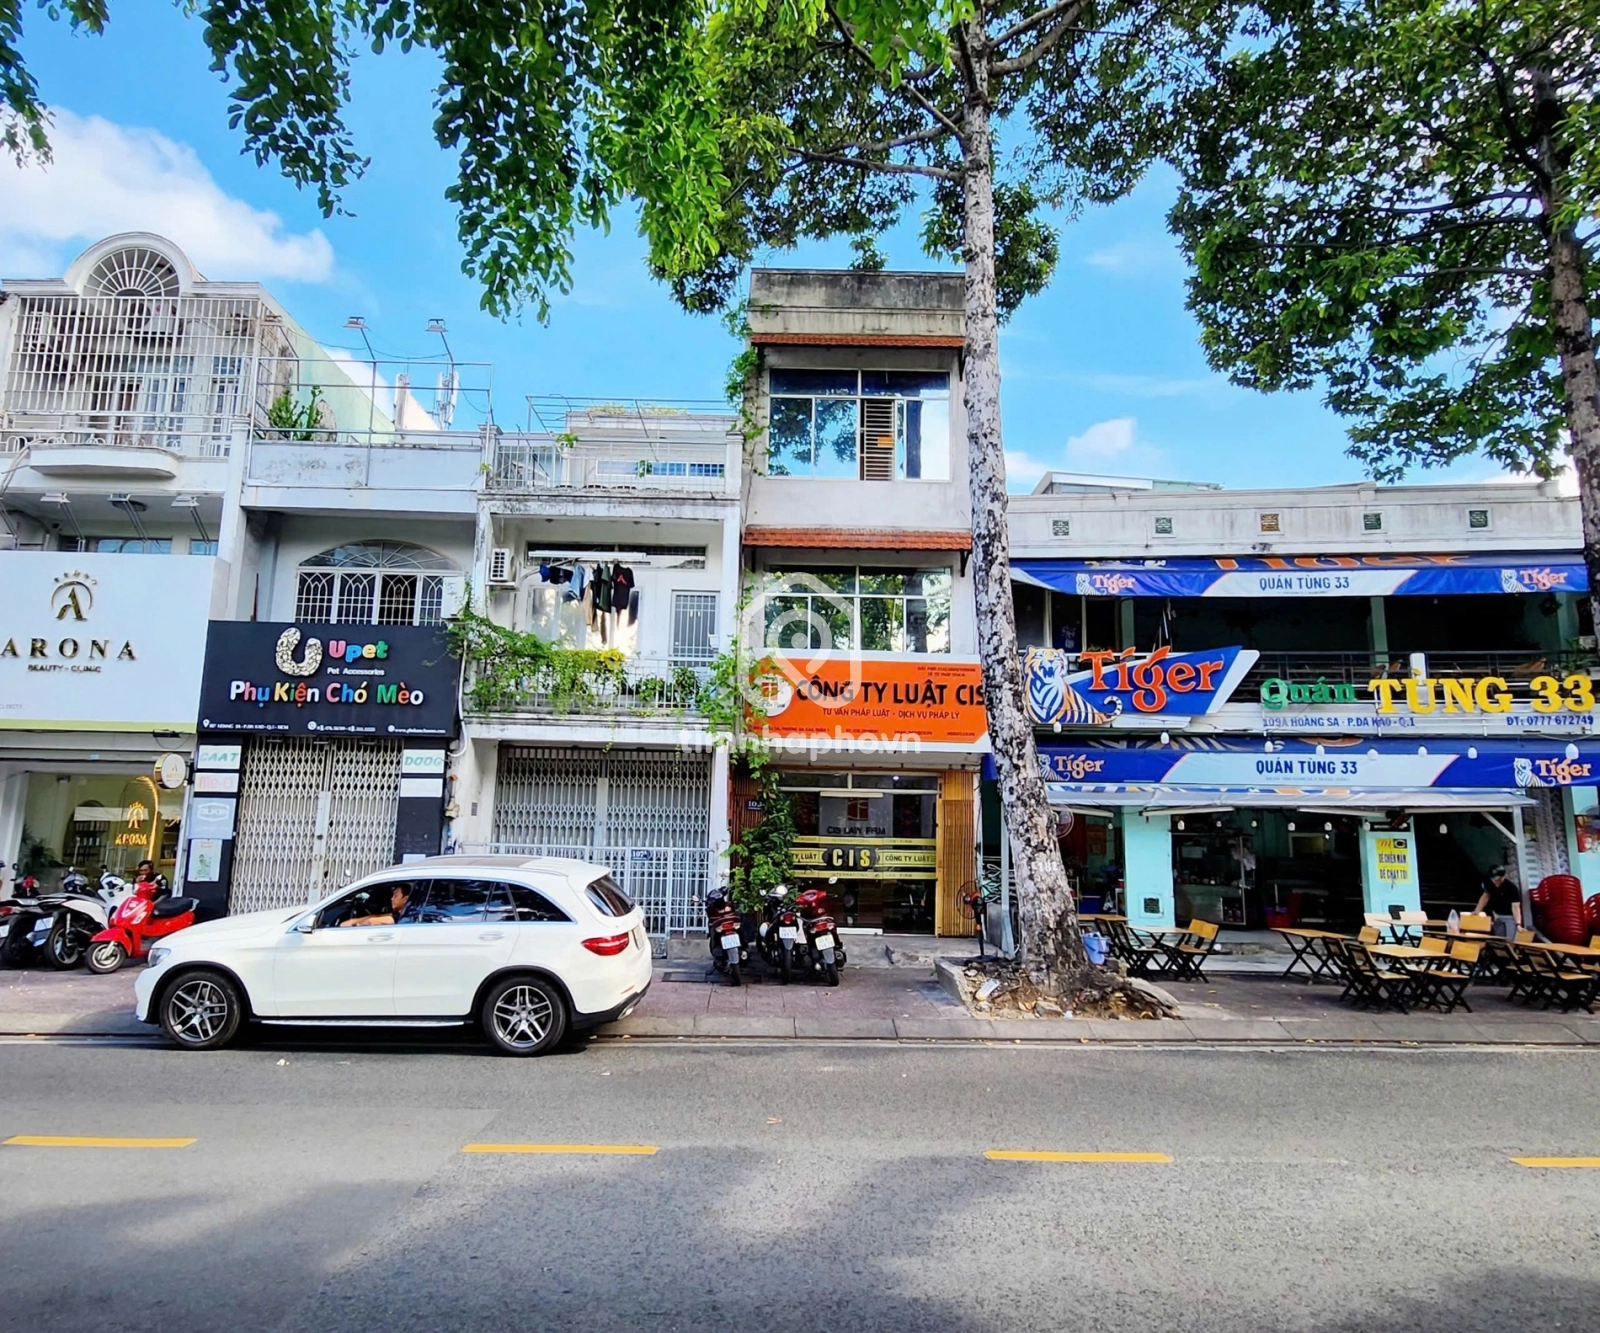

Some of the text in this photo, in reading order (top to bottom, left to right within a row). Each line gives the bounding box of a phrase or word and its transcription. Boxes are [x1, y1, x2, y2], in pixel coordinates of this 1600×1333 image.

[1093, 573, 1135, 594] Tiger
[1260, 574, 1350, 591] QUÁN TÙNG 33
[1520, 567, 1568, 590] Tiger
[0, 636, 137, 661] ARONA
[328, 640, 390, 663] Upet
[28, 664, 63, 673] BEAUTY
[71, 665, 102, 673] CLINIC
[327, 667, 385, 676] Pet Accessories
[1079, 645, 1223, 713] Tiger
[230, 681, 424, 708] Phụ Kiện Chó Mèo
[796, 674, 854, 701] CÔNG
[860, 682, 888, 703] TY
[893, 679, 947, 708] LUẬT
[1260, 667, 1596, 714] Quán TÙNG 33
[851, 708, 871, 717] PHÁP
[872, 709, 890, 717] LUẬT
[898, 710, 914, 718] DỊCH
[917, 711, 927, 719] VỤ
[929, 710, 949, 719] PHÁP
[951, 711, 960, 719] LÝ
[1262, 717, 1288, 727] 109A
[1291, 715, 1324, 727] HOÀNG
[1327, 717, 1340, 726] SA
[1526, 716, 1552, 726] 0777
[1554, 715, 1594, 726] 672749
[1054, 754, 1105, 779] Tiger
[1256, 757, 1357, 775] QUÁN TÙNG 33
[1535, 757, 1591, 784] Tiger
[827, 826, 842, 835] CIS
[832, 848, 871, 867] CIS
